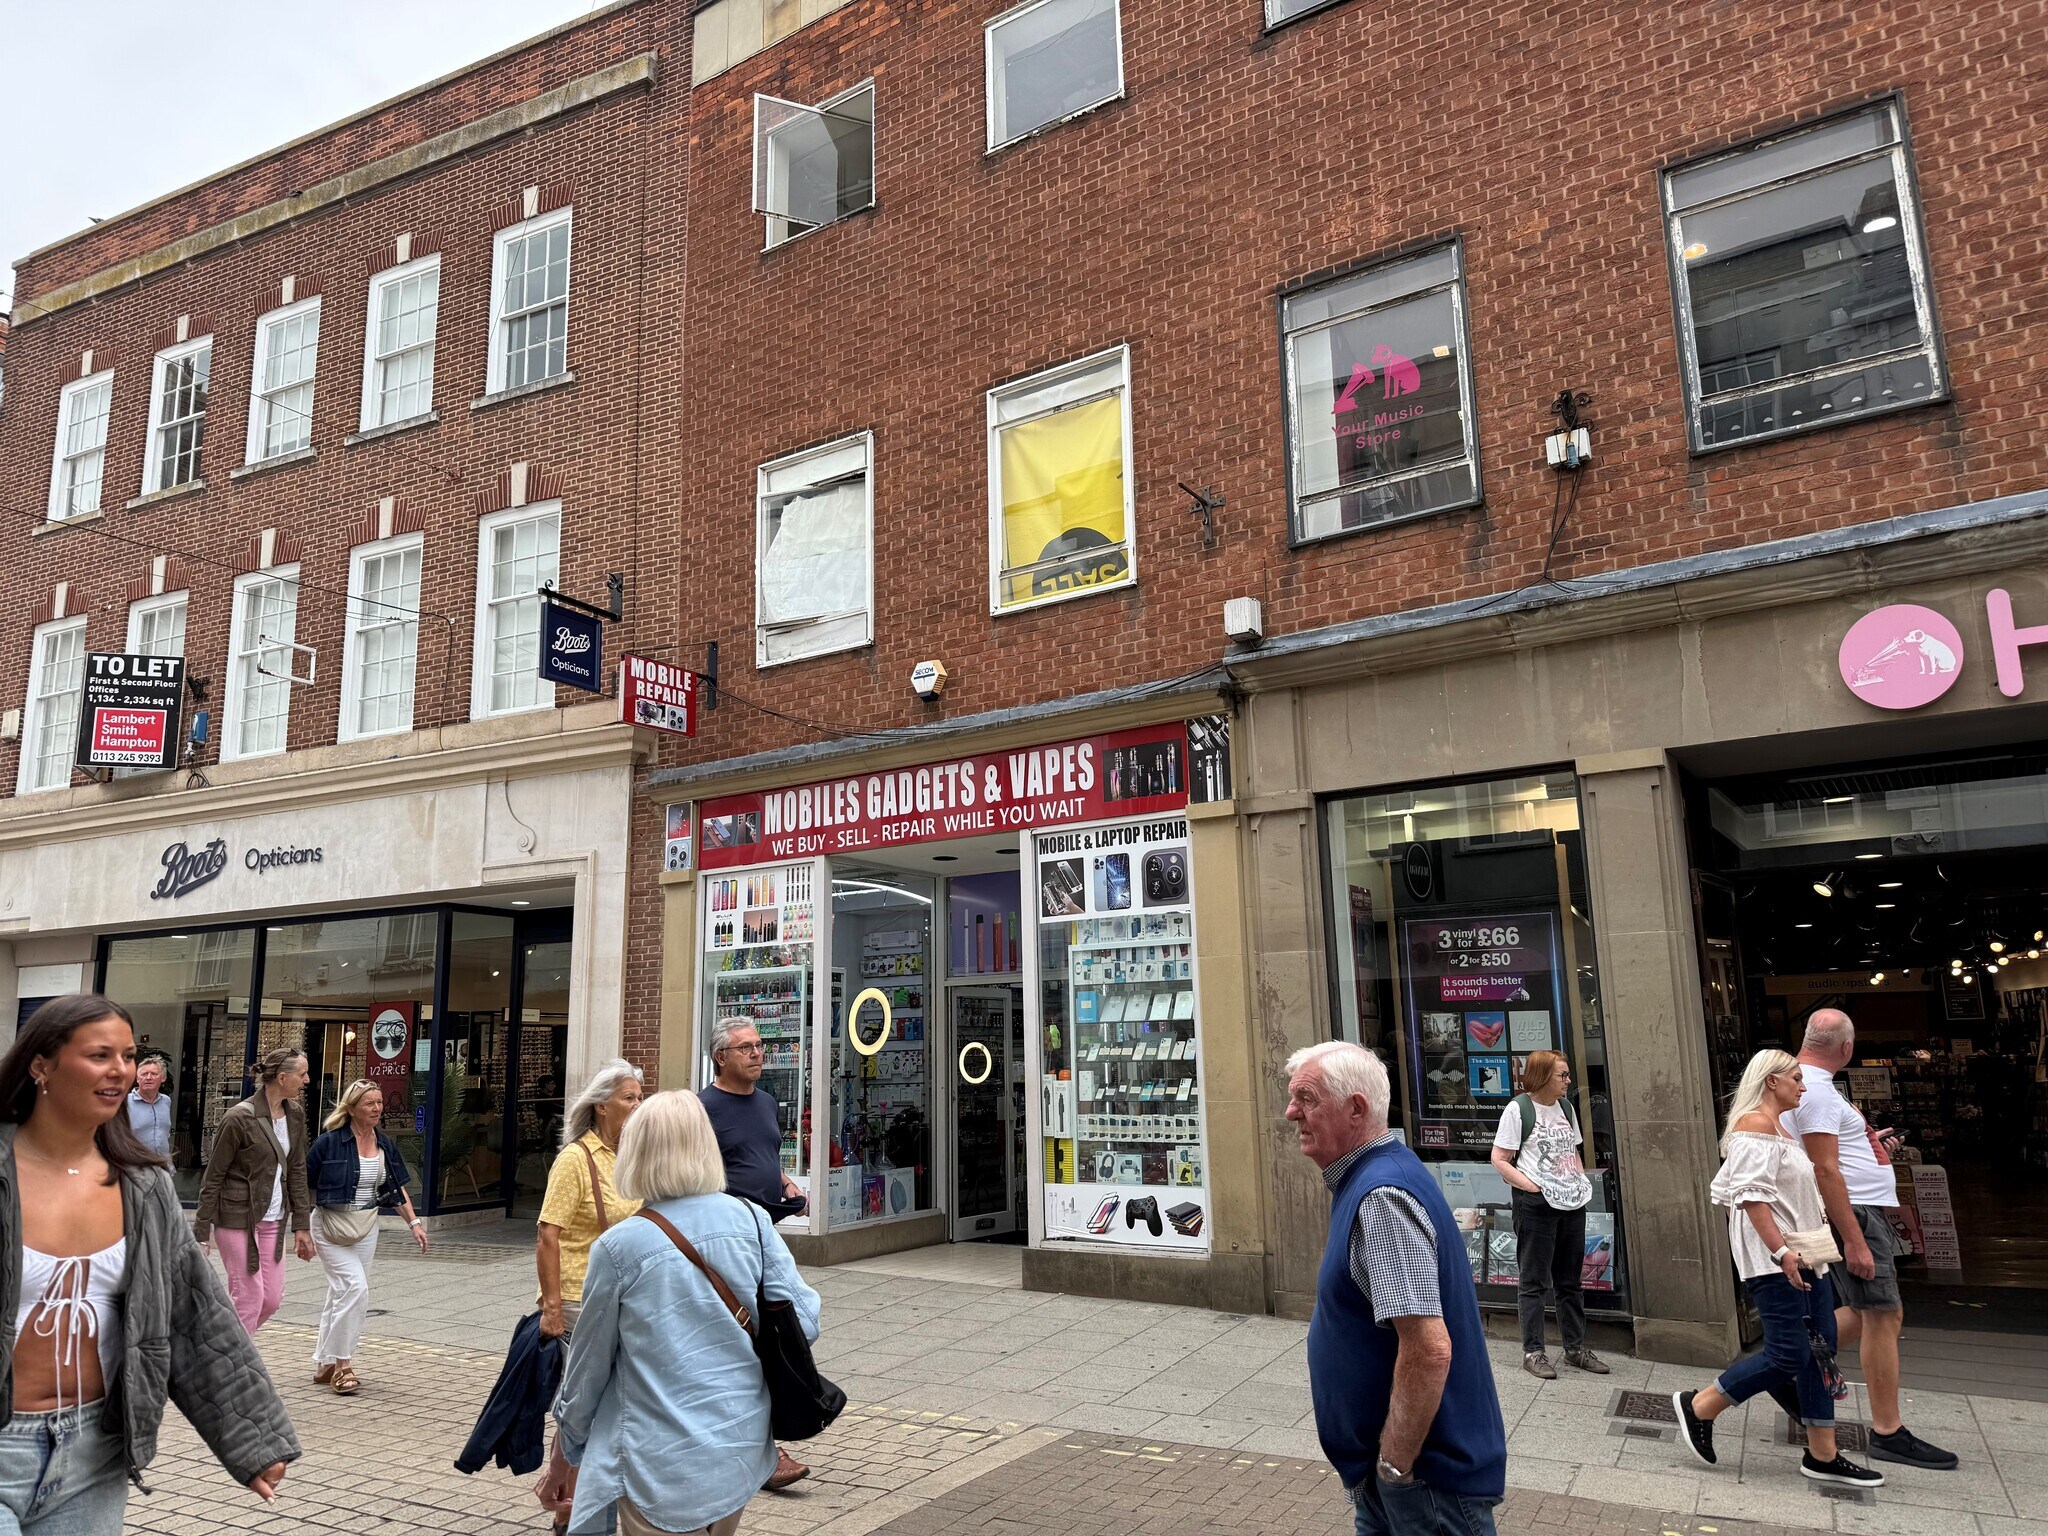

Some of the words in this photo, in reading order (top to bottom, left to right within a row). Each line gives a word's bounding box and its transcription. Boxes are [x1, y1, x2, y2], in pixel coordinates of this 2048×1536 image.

[1332, 420, 1369, 436] Your
[1374, 404, 1424, 427] Music
[1356, 429, 1401, 449] Store
[551, 626, 591, 655] Boots
[92, 655, 125, 676] TO
[131, 657, 180, 678] LET
[551, 656, 590, 677] Opticians
[630, 656, 692, 692] MOBILE
[89, 676, 111, 685] First
[112, 678, 120, 686] &
[121, 678, 153, 687] Second
[154, 679, 178, 688] Floor
[88, 685, 119, 694] Offices
[636, 680, 687, 707] REPAIR
[88, 694, 115, 704] 1,134
[123, 695, 151, 705] 2,334
[152, 698, 164, 707] sq
[166, 697, 175, 706] ft
[102, 712, 156, 725] Lambert
[101, 724, 138, 736] Smith
[100, 735, 157, 749] Hampton
[92, 752, 116, 761] 0113
[117, 753, 136, 762] 245
[137, 754, 161, 763] 9393
[764, 779, 860, 836] MOBILES
[867, 760, 976, 821] GADGETS
[983, 763, 1003, 804] &
[1008, 742, 1096, 800] VAPES
[771, 838, 795, 857] WE
[797, 832, 827, 854] BUY
[836, 826, 871, 848] SELL
[881, 817, 936, 842] REPAIR
[943, 808, 995, 833] WHILE
[998, 803, 1036, 827] YOU
[1038, 797, 1086, 820] WAIT
[1038, 834, 1081, 856] MOBILE
[1083, 833, 1093, 850] &
[1095, 826, 1141, 849] LAPTOP
[1143, 820, 1187, 844] REPAIR
[244, 844, 323, 875] Opticians
[150, 837, 228, 900] Boots
[1438, 929, 1452, 949] 3
[1452, 928, 1477, 940] vinyl
[1477, 926, 1520, 947] £66
[1457, 938, 1473, 948] for
[1459, 954, 1469, 967] 2
[1469, 956, 1480, 964] for
[1481, 952, 1511, 967] £50
[1443, 977, 1450, 987] it
[1451, 976, 1489, 987] sounds
[1490, 975, 1523, 986] better
[1443, 989, 1456, 997] on
[1458, 986, 1482, 998] vinyl
[1516, 1019, 1547, 1032] WILD
[1517, 1031, 1546, 1042] GOD
[1424, 1136, 1445, 1144] FANS
[1461, 1130, 1474, 1138] vinyl
[1463, 1137, 1474, 1145] pop
